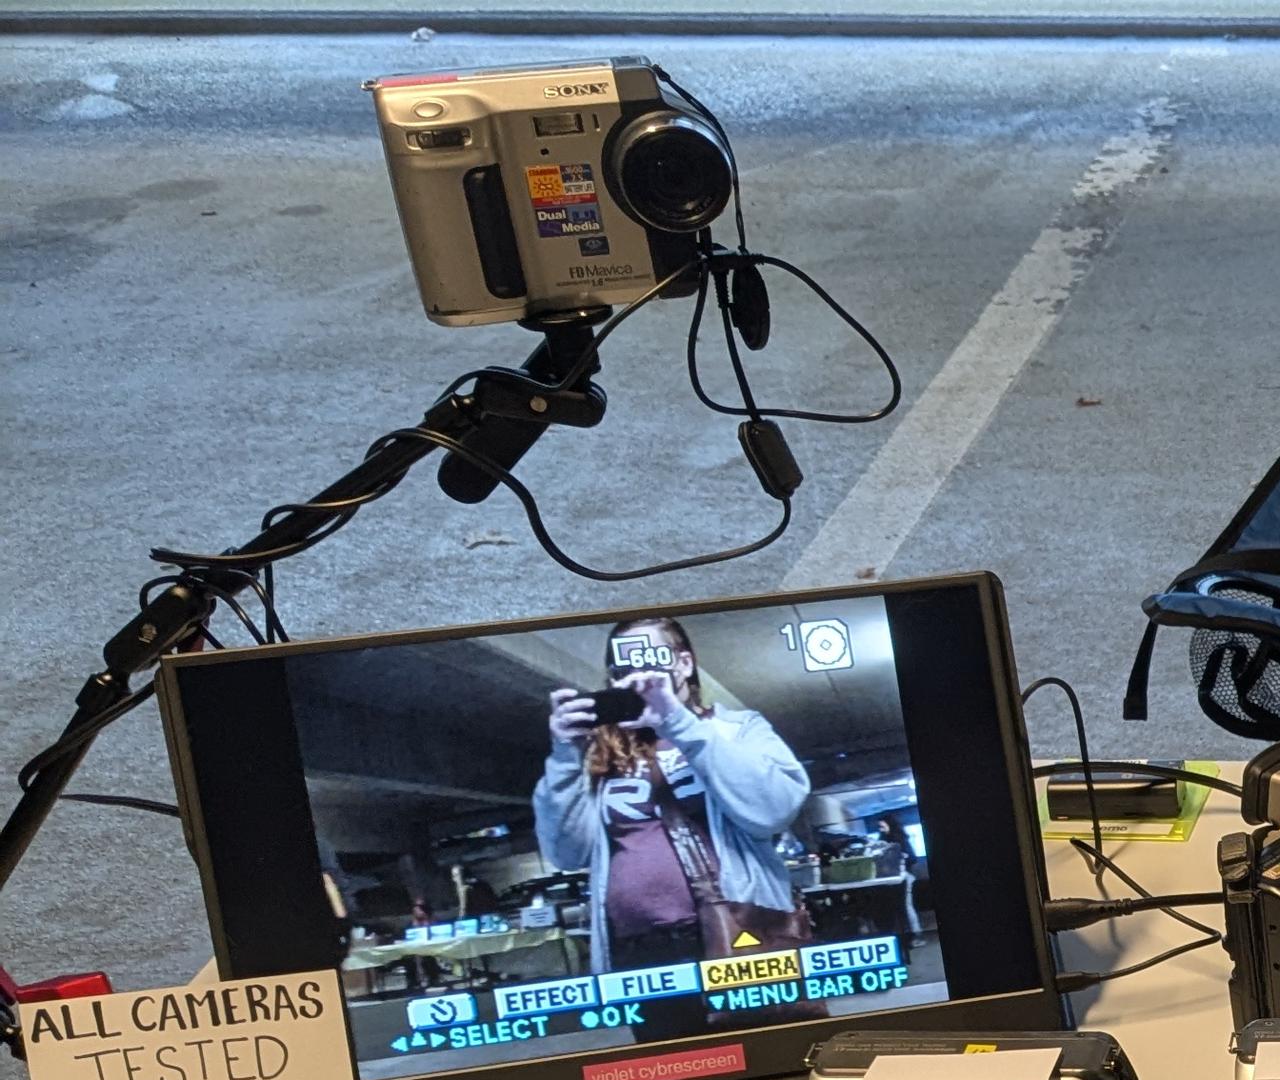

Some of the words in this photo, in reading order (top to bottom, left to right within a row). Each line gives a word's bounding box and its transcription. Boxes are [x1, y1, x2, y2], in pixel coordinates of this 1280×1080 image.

[544, 83, 609, 99] SONY
[538, 211, 566, 221] Dual
[562, 222, 600, 233] Media
[780, 623, 796, 650] 1
[629, 647, 671, 668] 640
[505, 982, 590, 1013] EFFECT
[622, 971, 677, 996] FILE
[707, 955, 798, 986] CAMERA
[810, 942, 891, 972] SETUP
[31, 1001, 122, 1044] ALL
[131, 980, 324, 1033] CAMERAS
[450, 1015, 549, 1048] SELECT
[605, 1003, 645, 1028] OK
[728, 982, 799, 1012] MENU
[805, 974, 854, 1000] BAR
[863, 966, 910, 993] OFF
[638, 1050, 738, 1080] cybrescreen
